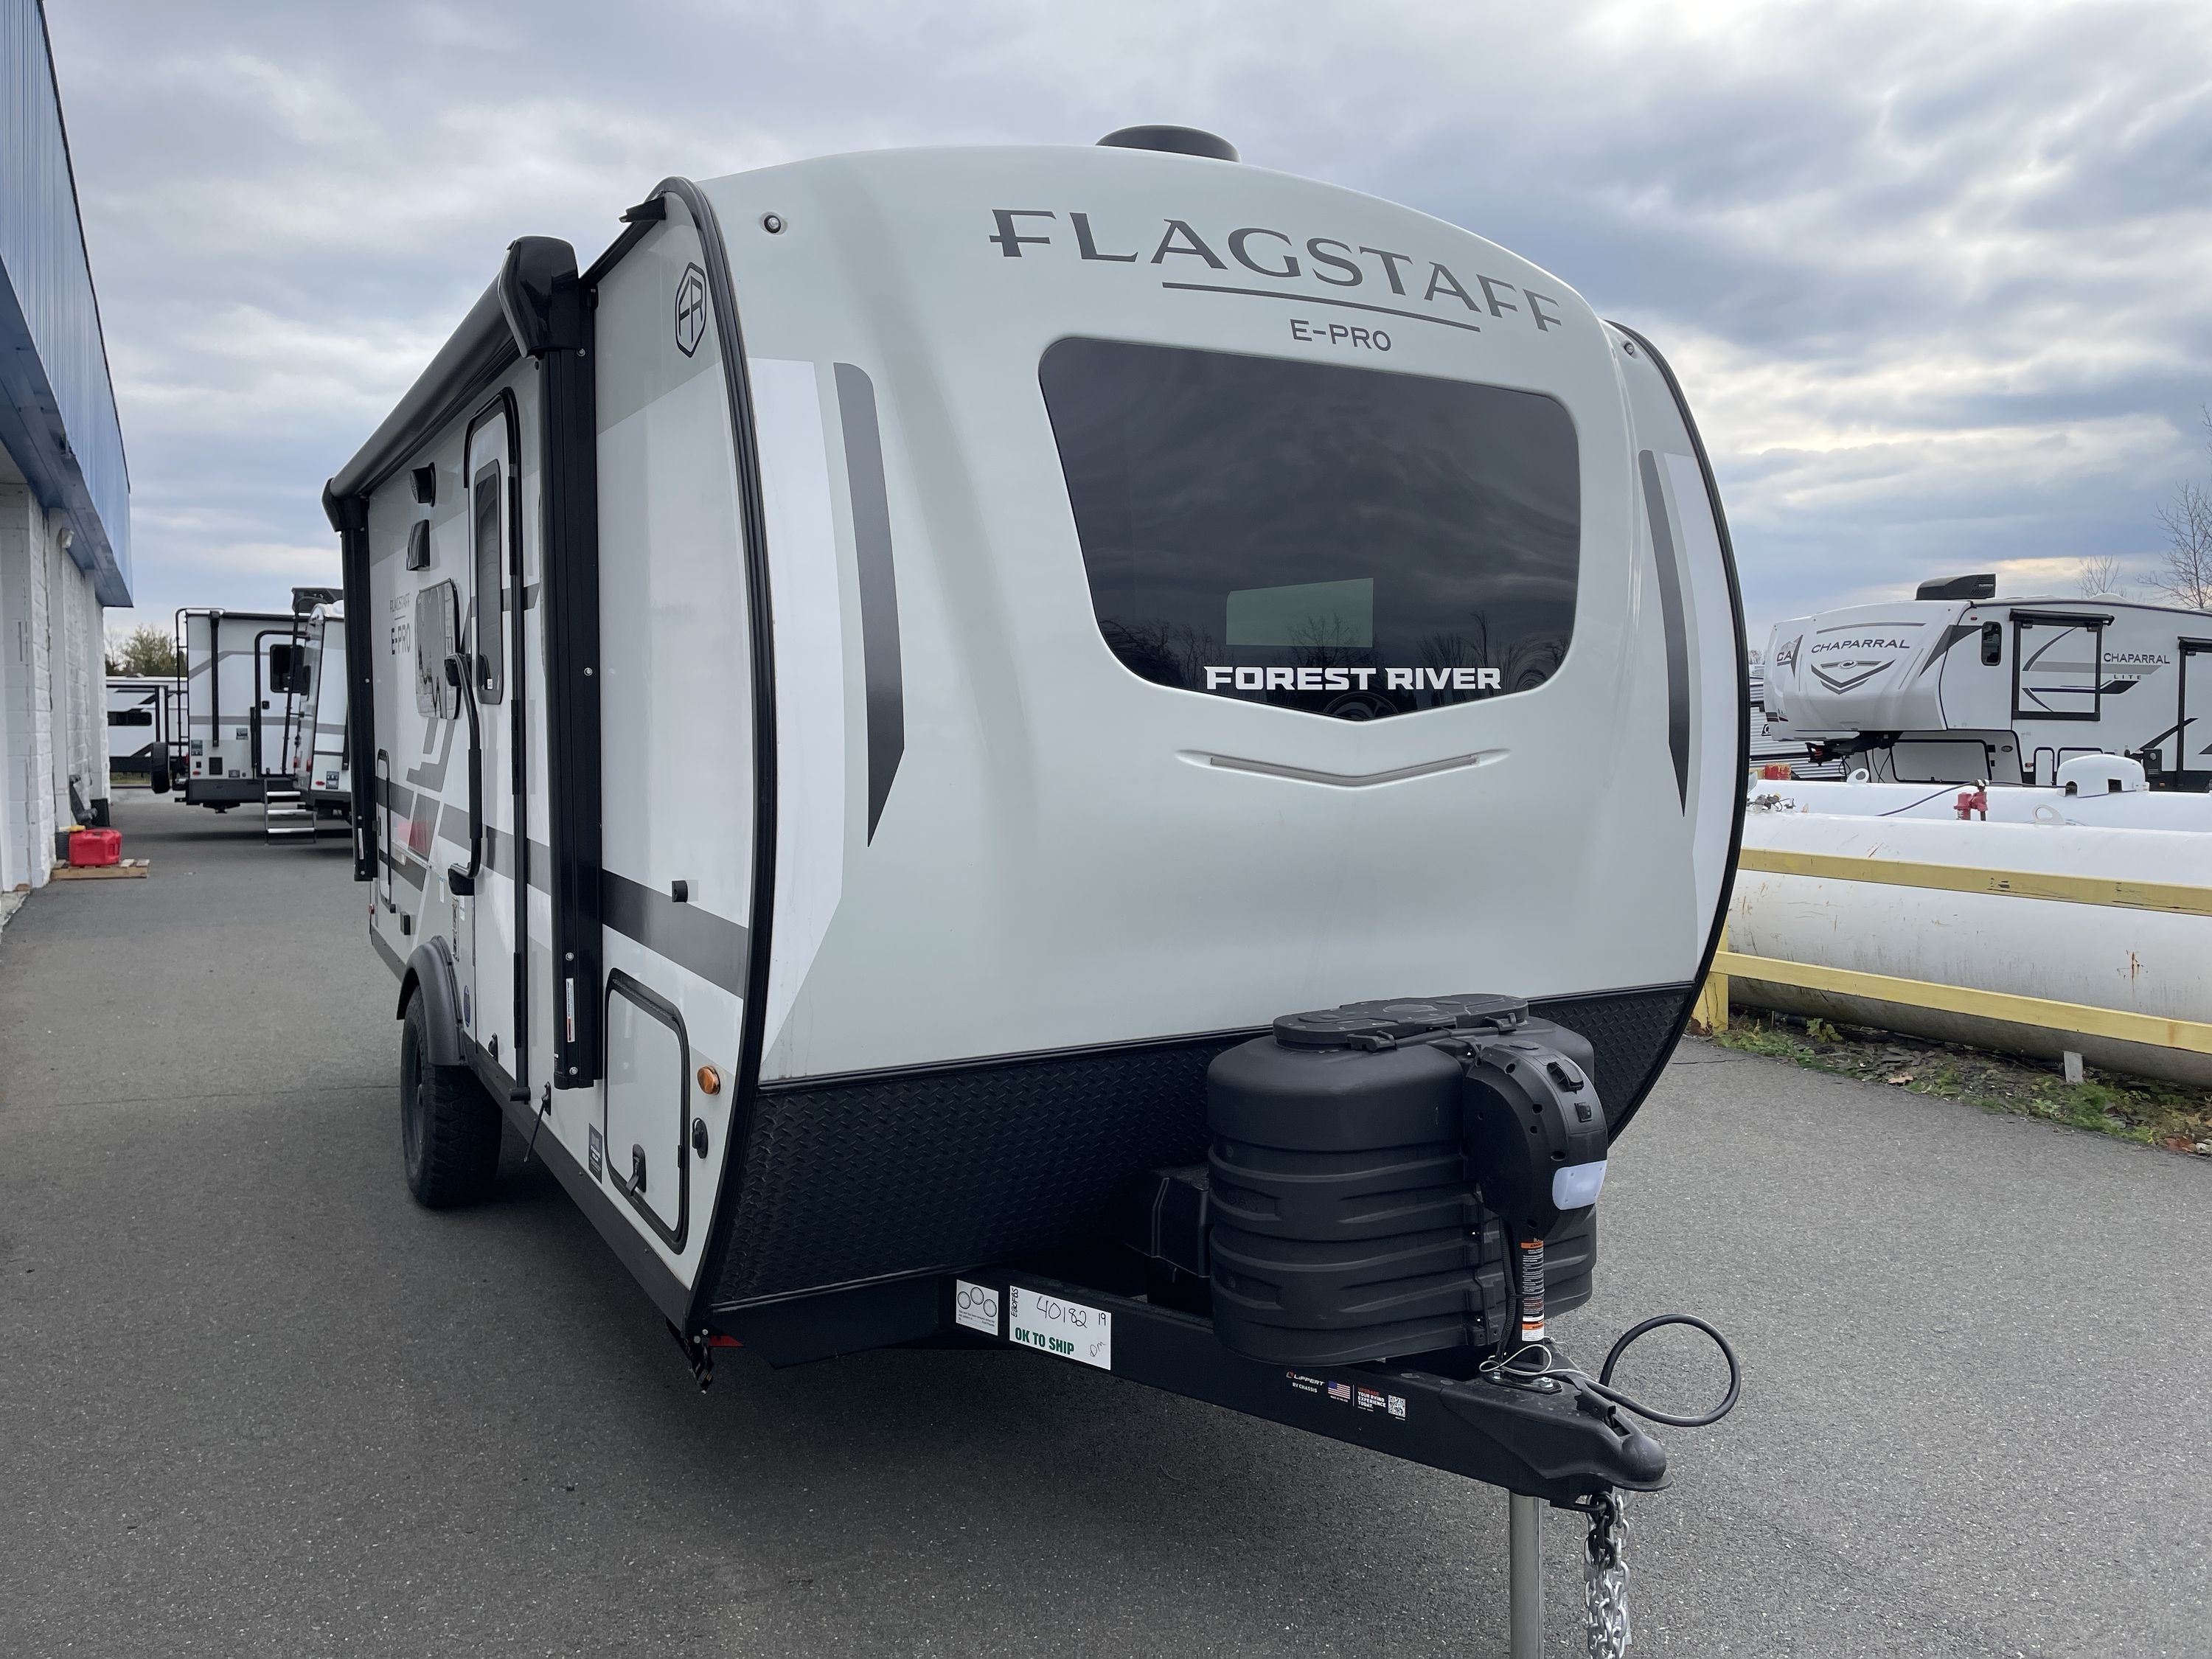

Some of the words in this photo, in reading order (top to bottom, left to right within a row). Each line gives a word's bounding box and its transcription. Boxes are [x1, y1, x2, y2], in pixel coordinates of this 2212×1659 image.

[989, 209, 1562, 332] FLAGSTAFF
[1290, 319, 1392, 352] E-PRO
[391, 622, 411, 655] E-PRO
[1811, 639, 1910, 654] CHAPARRAL
[2103, 653, 2170, 664] CHAPARRAL
[1206, 666, 1377, 690] FOREST
[1385, 667, 1501, 690] RIVER
[1036, 1295, 1088, 1329] 40182
[1015, 1326, 1030, 1343] OK
[1032, 1332, 1046, 1348] TO
[1048, 1337, 1074, 1355] SHIP
[1298, 1384, 1318, 1393] CHASSIS
[1357, 1396, 1386, 1408] EXPERIENCE
